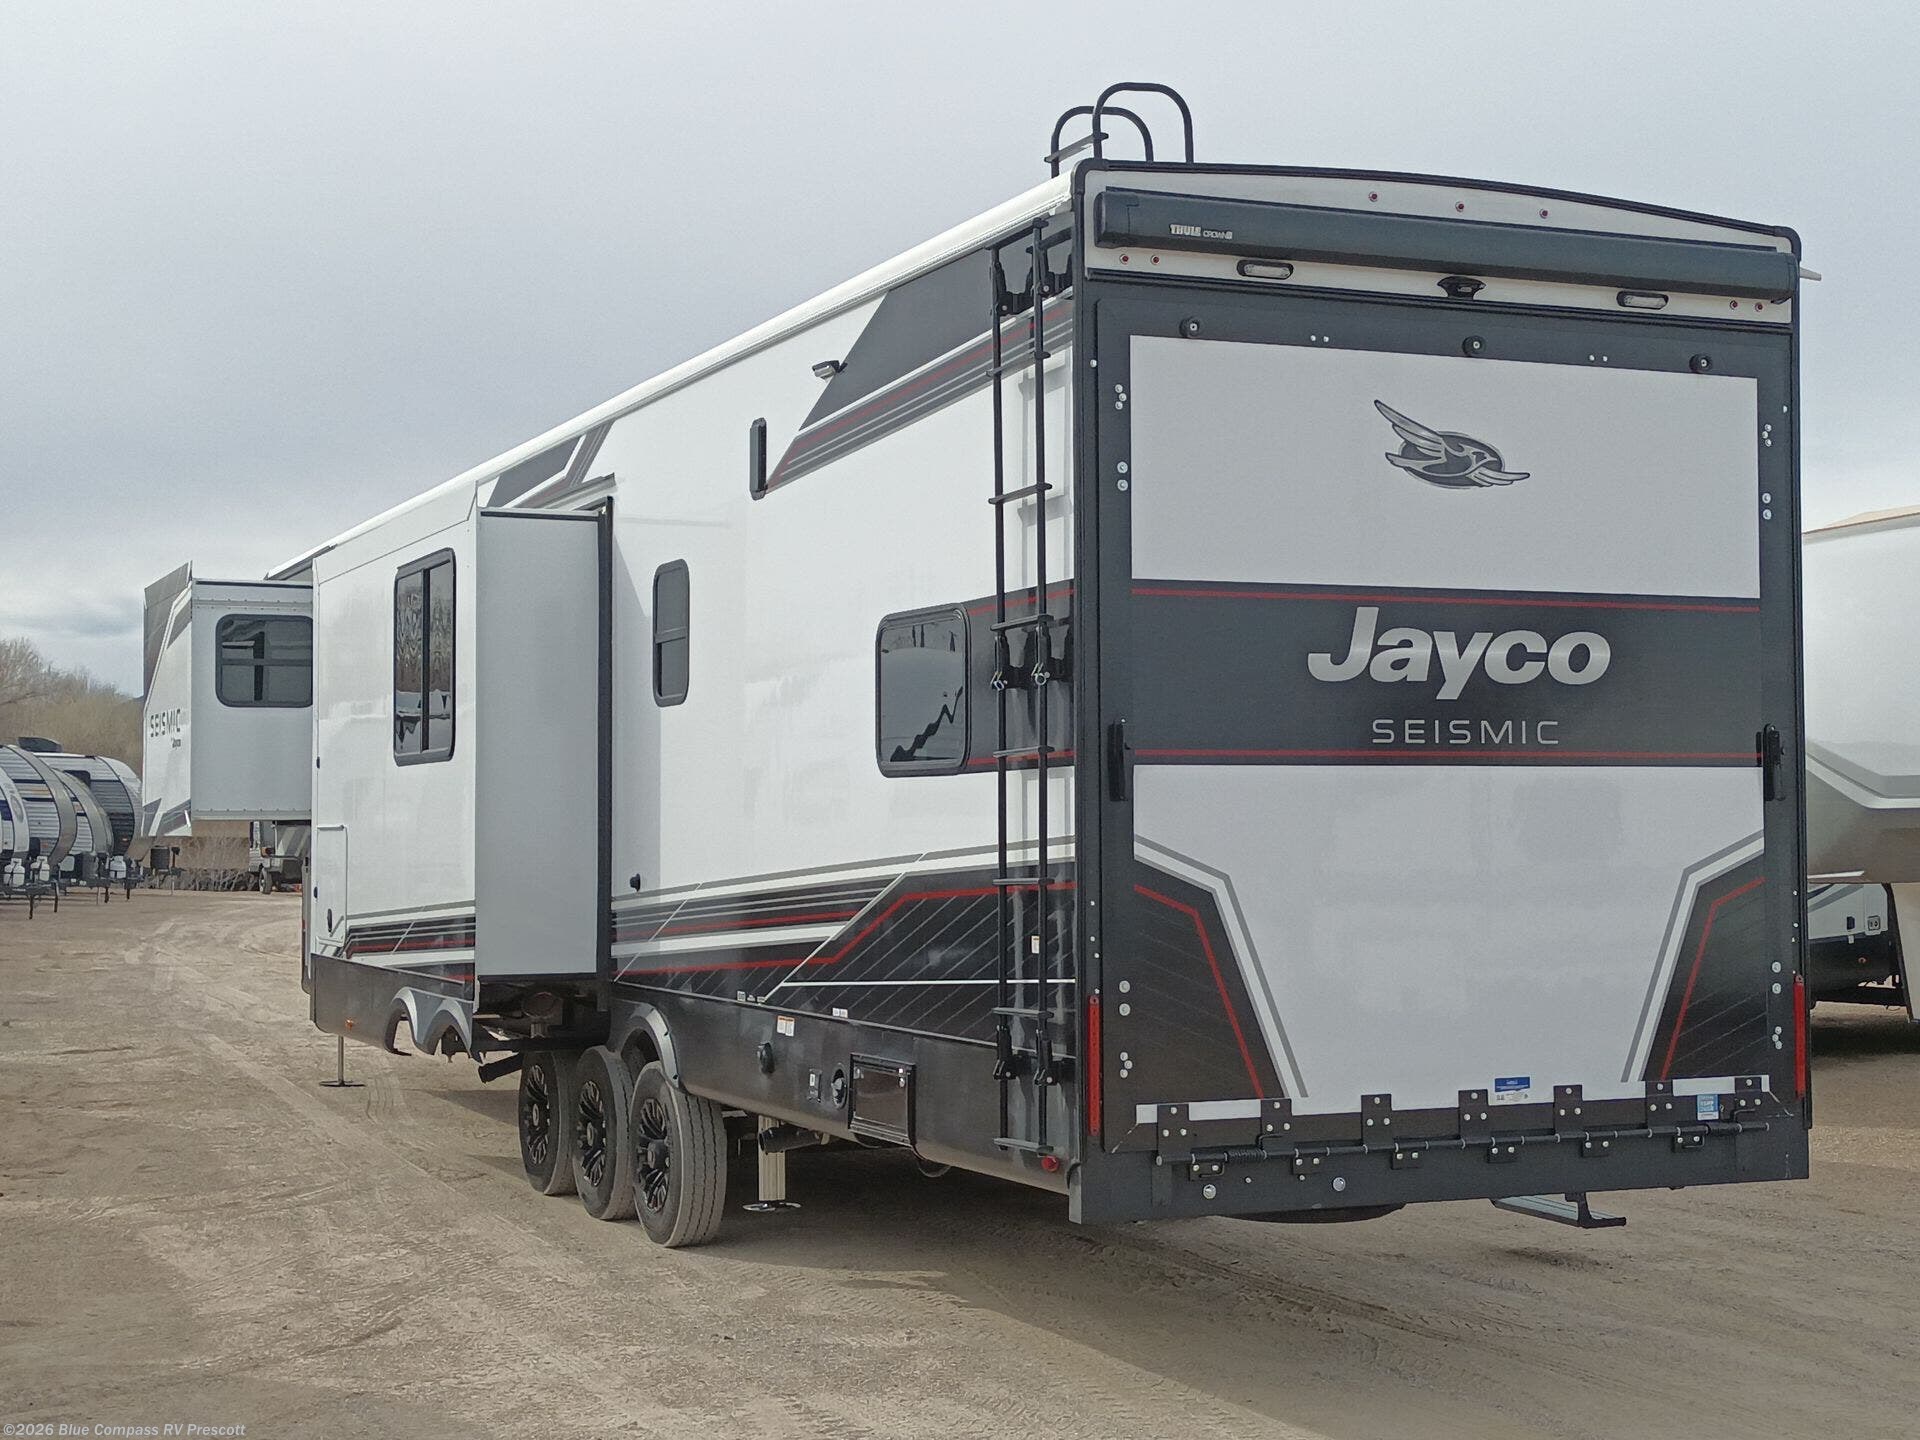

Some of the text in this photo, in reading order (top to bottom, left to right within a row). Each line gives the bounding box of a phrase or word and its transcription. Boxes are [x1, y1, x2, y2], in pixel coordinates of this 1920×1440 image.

[1307, 606, 1611, 700] Jayco
[150, 708, 181, 738] SEISMIC
[1372, 719, 1559, 745] SEISMIC
